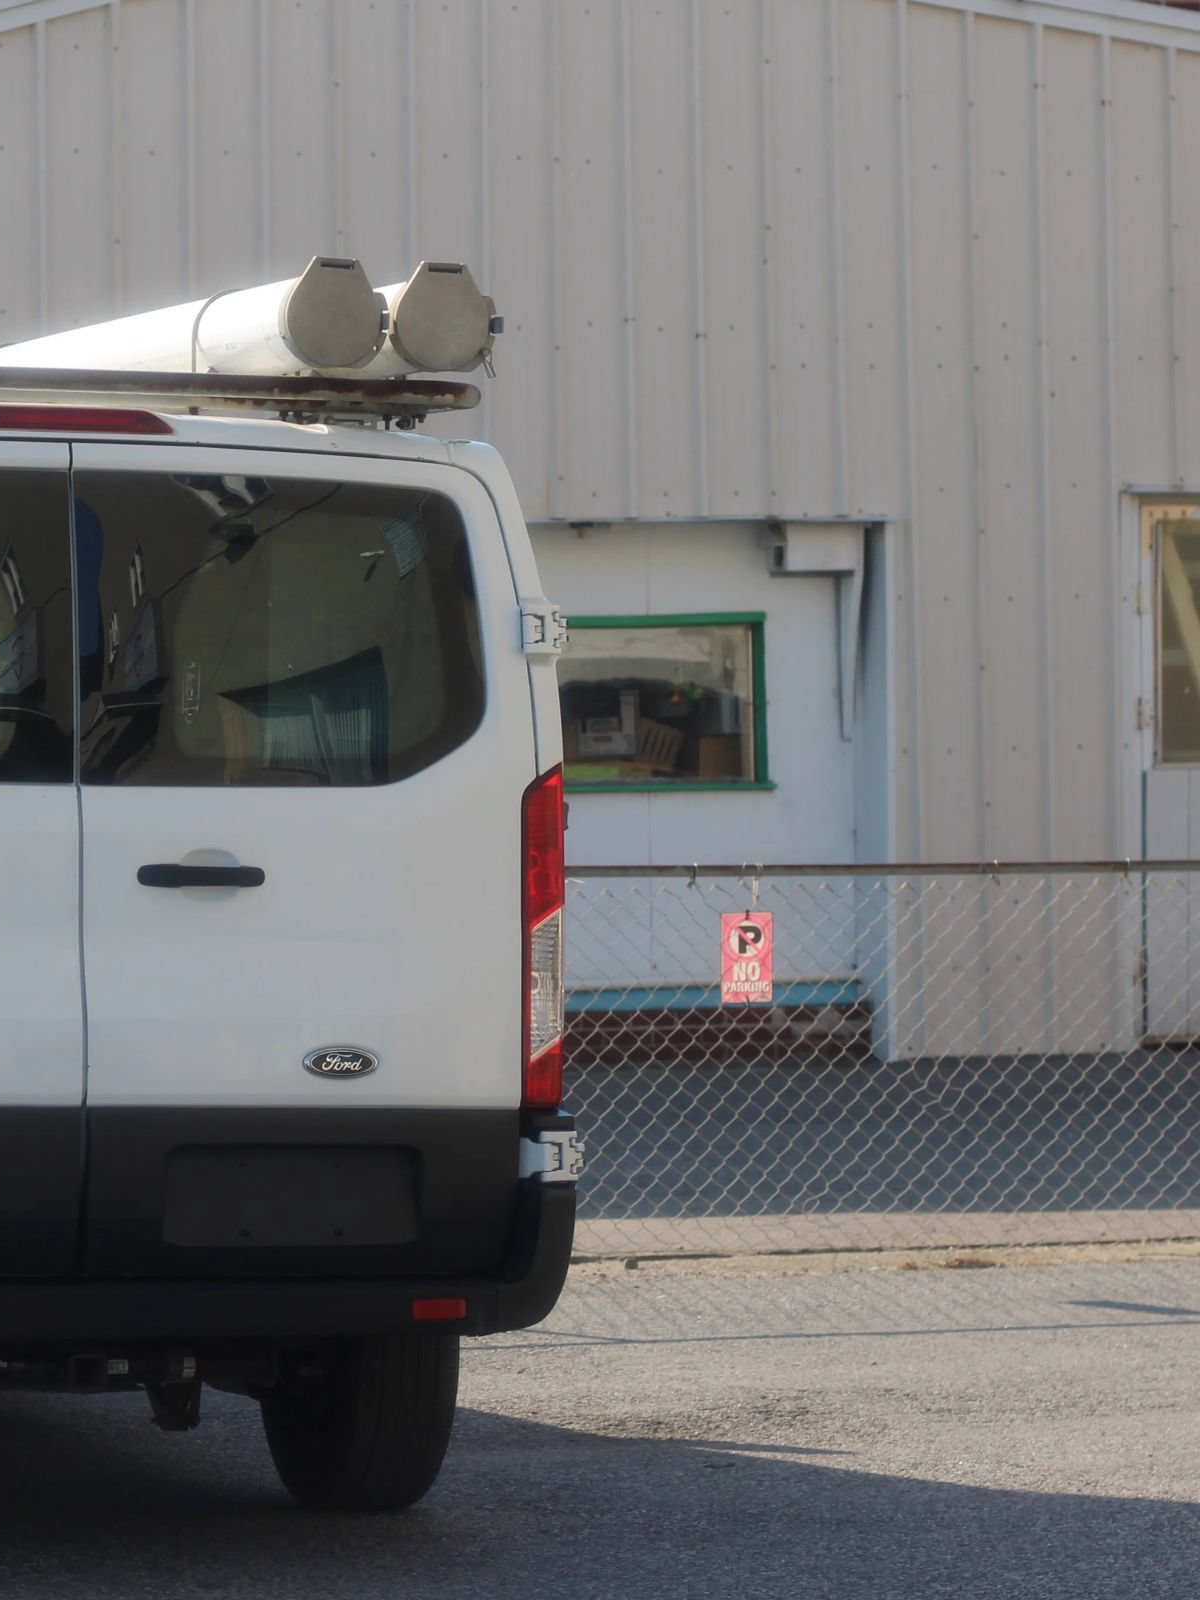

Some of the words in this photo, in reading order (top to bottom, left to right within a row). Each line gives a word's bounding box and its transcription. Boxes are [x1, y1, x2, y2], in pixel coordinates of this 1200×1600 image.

[733, 960, 761, 981] NO
[724, 981, 769, 992] PARKING
[321, 1053, 363, 1071] Ford
